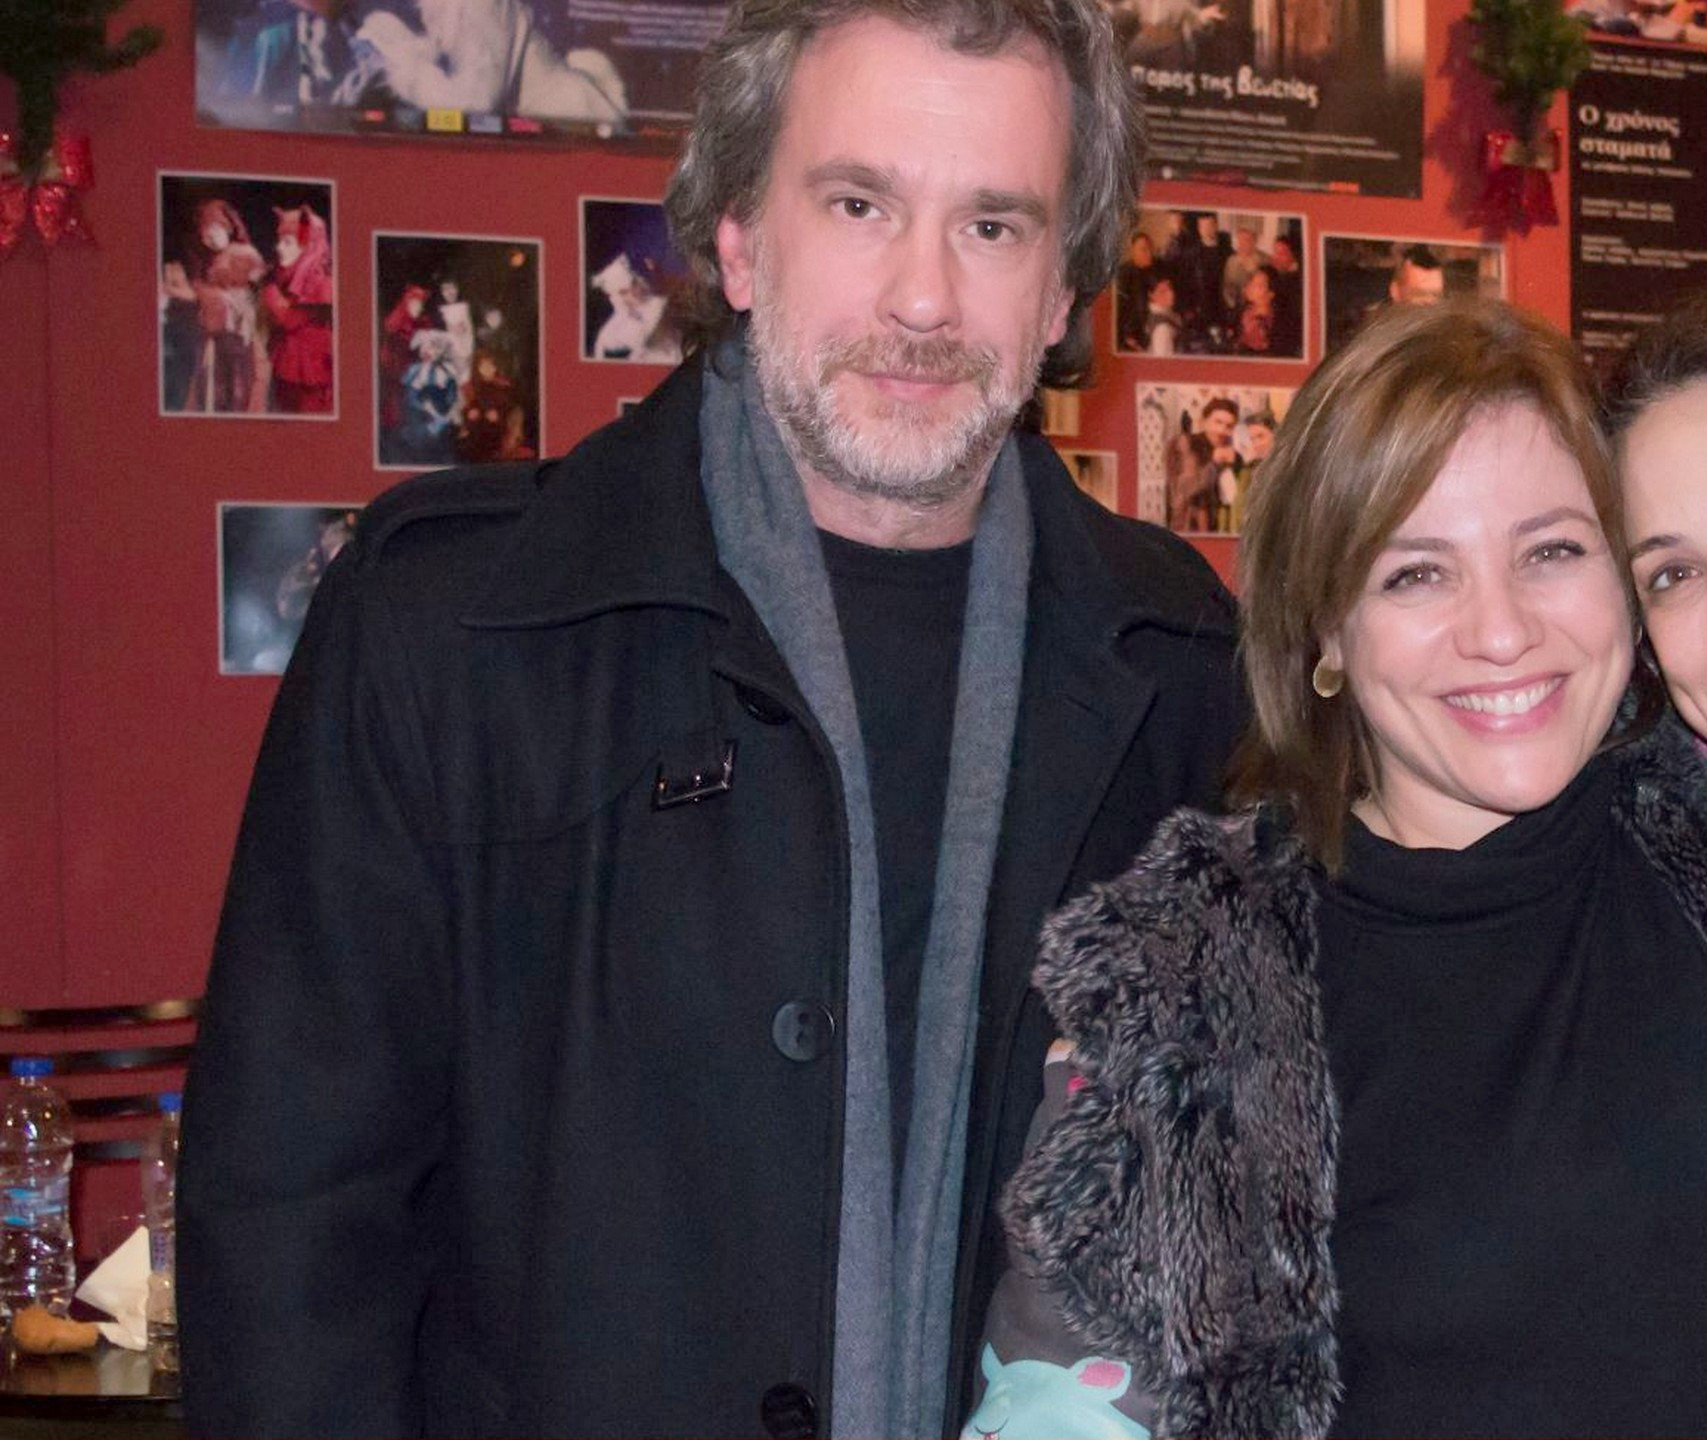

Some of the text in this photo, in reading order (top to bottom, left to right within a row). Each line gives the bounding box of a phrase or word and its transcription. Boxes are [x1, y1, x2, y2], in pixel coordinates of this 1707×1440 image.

[1579, 105, 1681, 135] Ο χρόνος
[1579, 138, 1672, 161] σταματά
